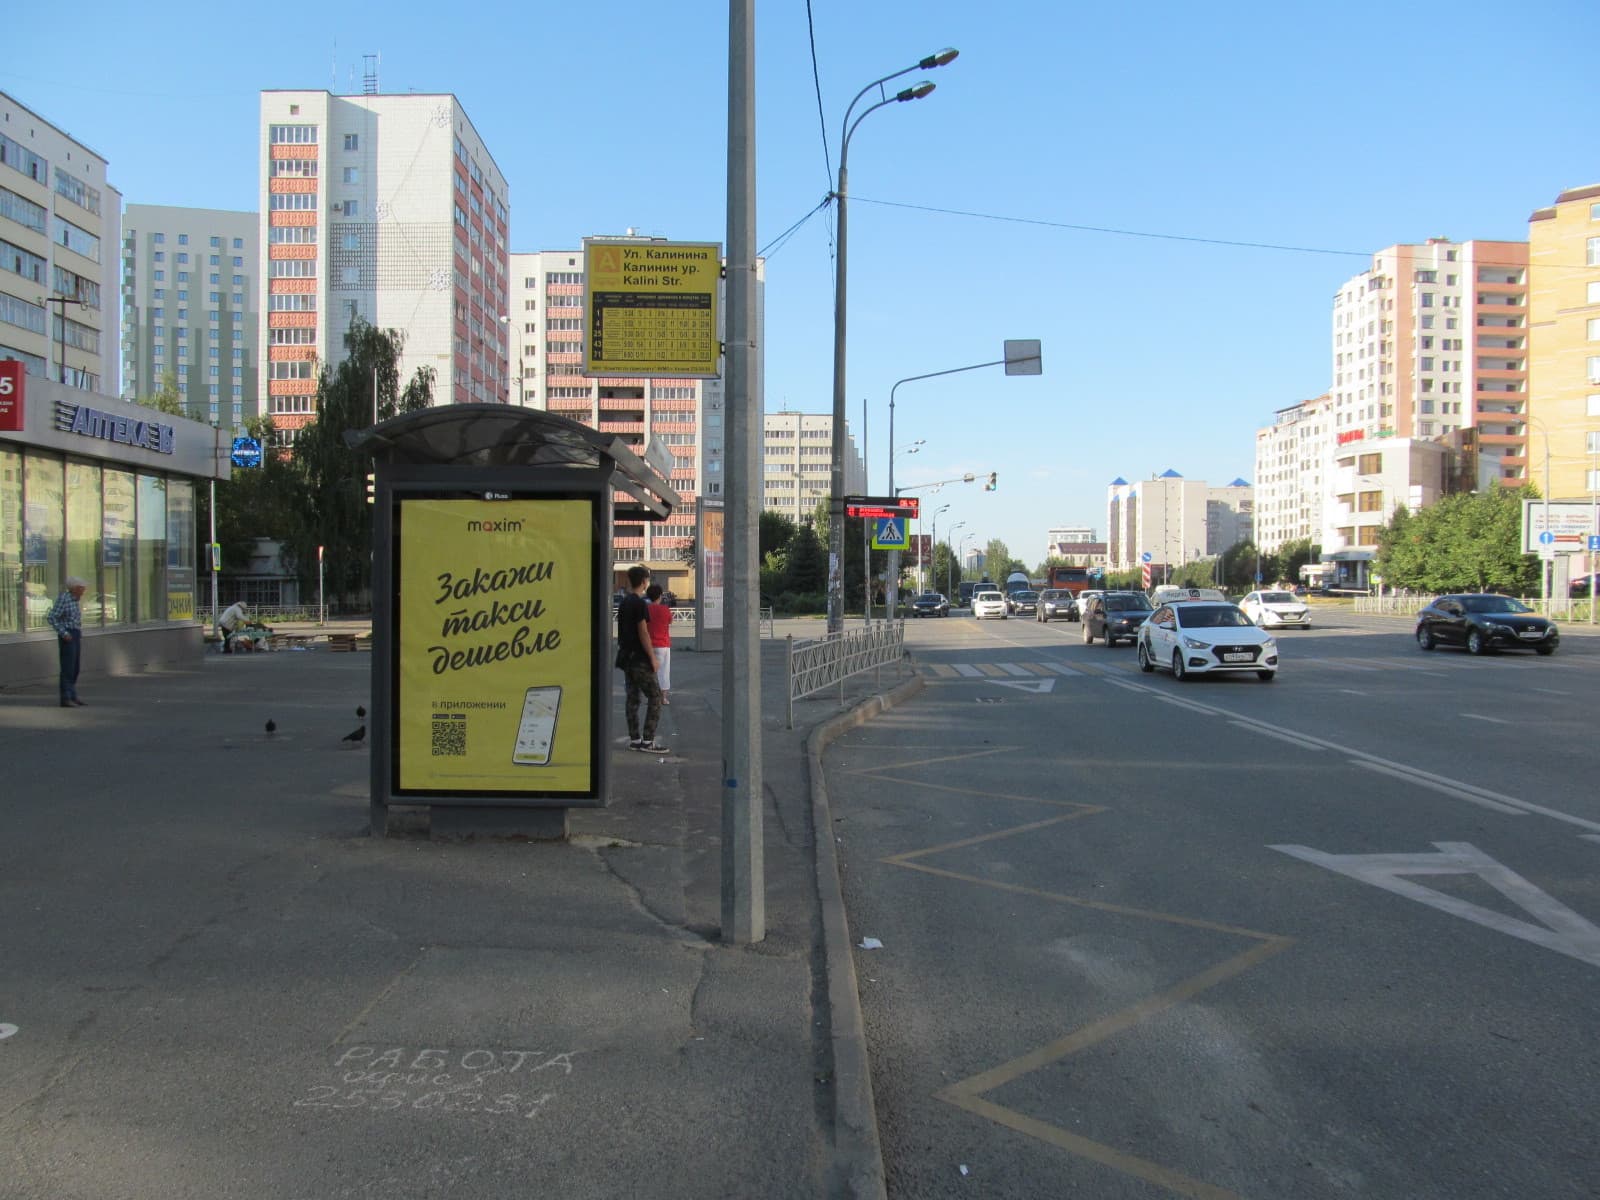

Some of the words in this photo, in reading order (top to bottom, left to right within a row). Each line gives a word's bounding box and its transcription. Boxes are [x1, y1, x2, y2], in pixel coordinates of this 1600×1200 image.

[624, 249, 642, 259] Ул.
[646, 249, 708, 260] Калинина
[623, 262, 678, 273] Калинин
[682, 265, 700, 275] ур.
[623, 275, 658, 286] Kalini
[662, 275, 683, 286] Str.
[71, 405, 151, 448] АПТЕКА
[467, 517, 522, 532] maxim
[435, 561, 554, 604] Закажи
[442, 600, 546, 637] такси
[428, 626, 561, 675] дешевле
[440, 700, 506, 710] приложении
[334, 1046, 577, 1074] РАБОТА
